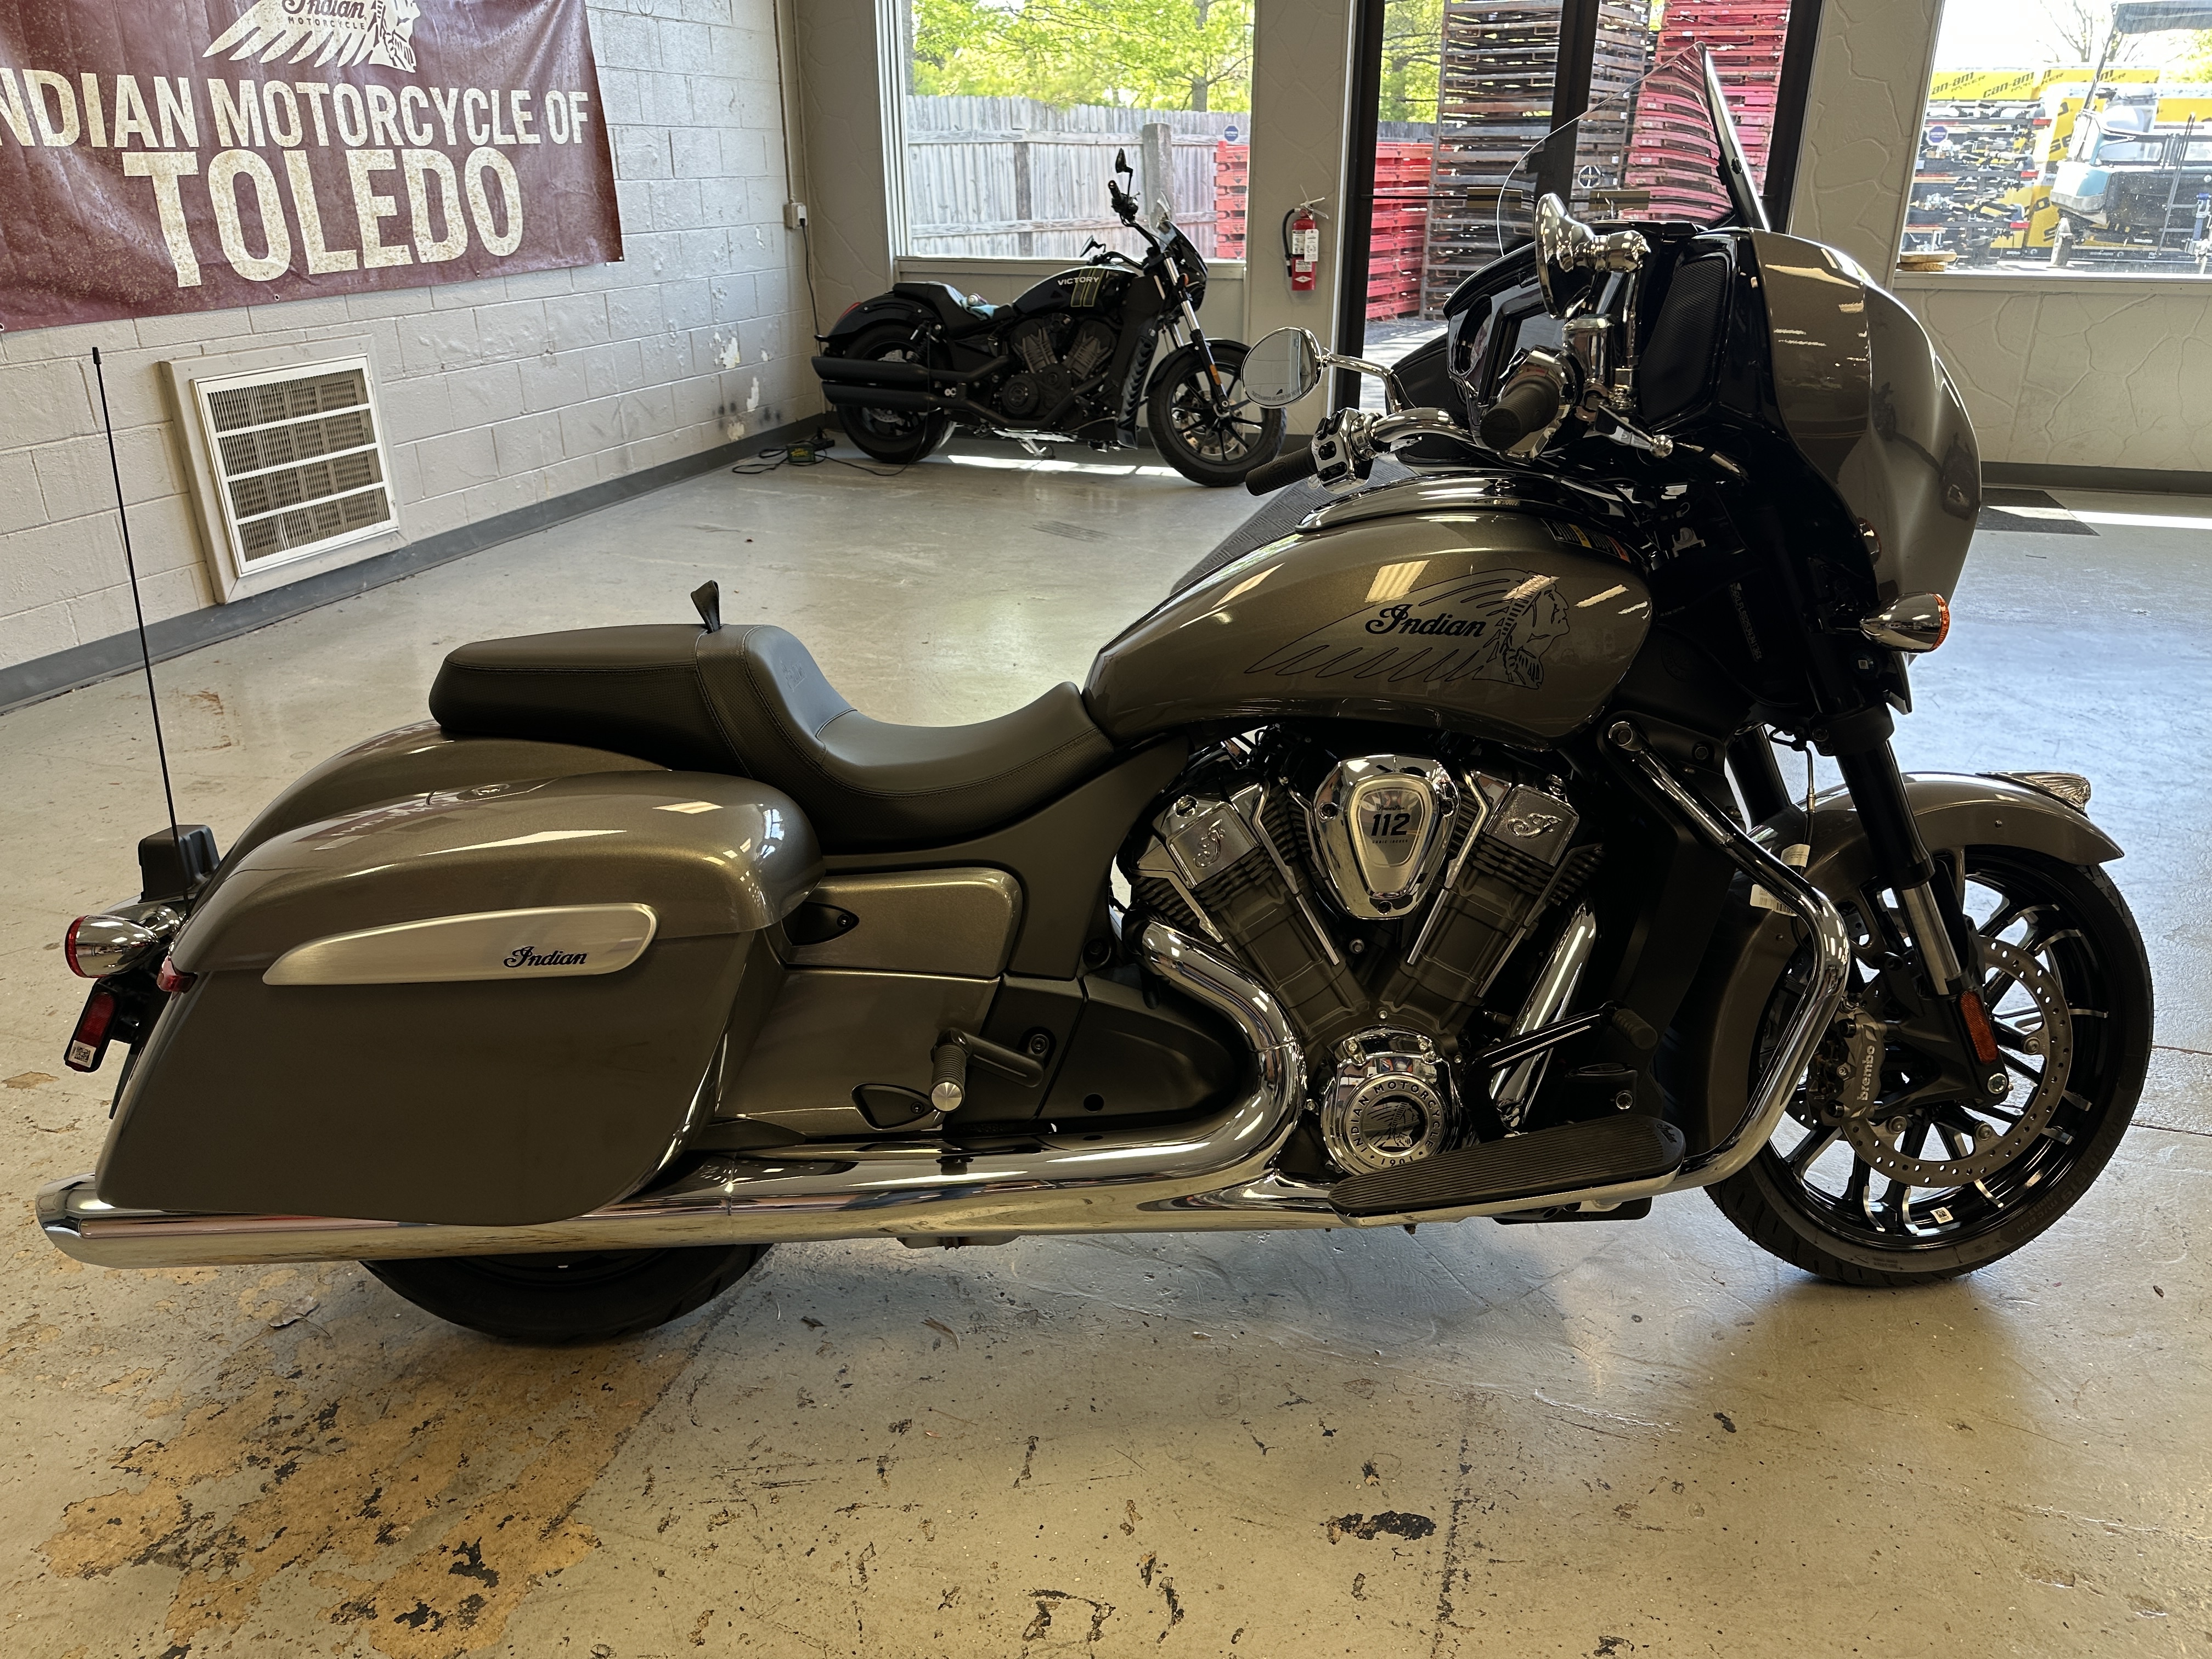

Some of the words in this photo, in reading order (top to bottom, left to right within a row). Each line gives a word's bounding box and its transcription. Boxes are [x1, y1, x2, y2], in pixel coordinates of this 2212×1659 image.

[287, 16, 365, 30] MOTORCYCLE
[1931, 72, 1974, 95] an-am
[207, 78, 540, 148] MOTORCYCLE
[546, 91, 588, 144] OF
[122, 146, 523, 288] TOLEDO
[1057, 276, 1100, 286] VICTORY
[1365, 604, 1487, 637] Indian
[1371, 812, 1411, 837] 112
[503, 946, 588, 968] Indian
[1857, 1045, 1876, 1101] brembo
[1351, 1095, 1370, 1153] INDIAN
[1373, 1081, 1441, 1148] MOTORCYCLE
[1381, 1155, 1414, 1167] 1901
